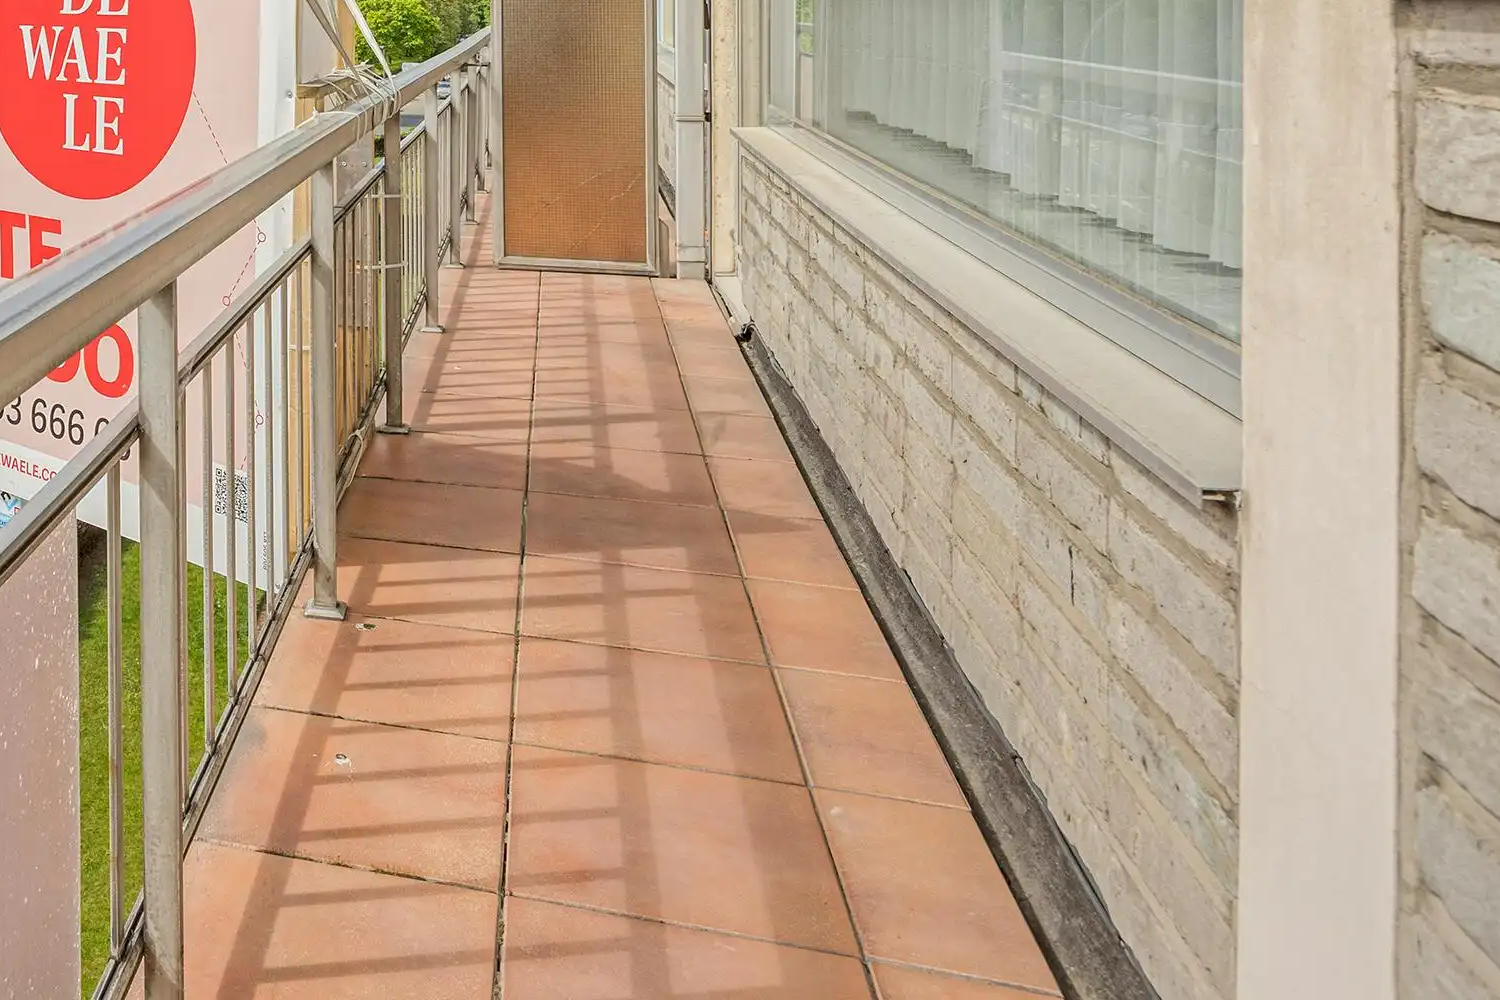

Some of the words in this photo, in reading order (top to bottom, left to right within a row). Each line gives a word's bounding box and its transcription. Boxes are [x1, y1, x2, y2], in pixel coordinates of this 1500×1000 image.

[18, 23, 128, 86] WAE
[61, 92, 125, 156] LE
[31, 397, 85, 446] 666
